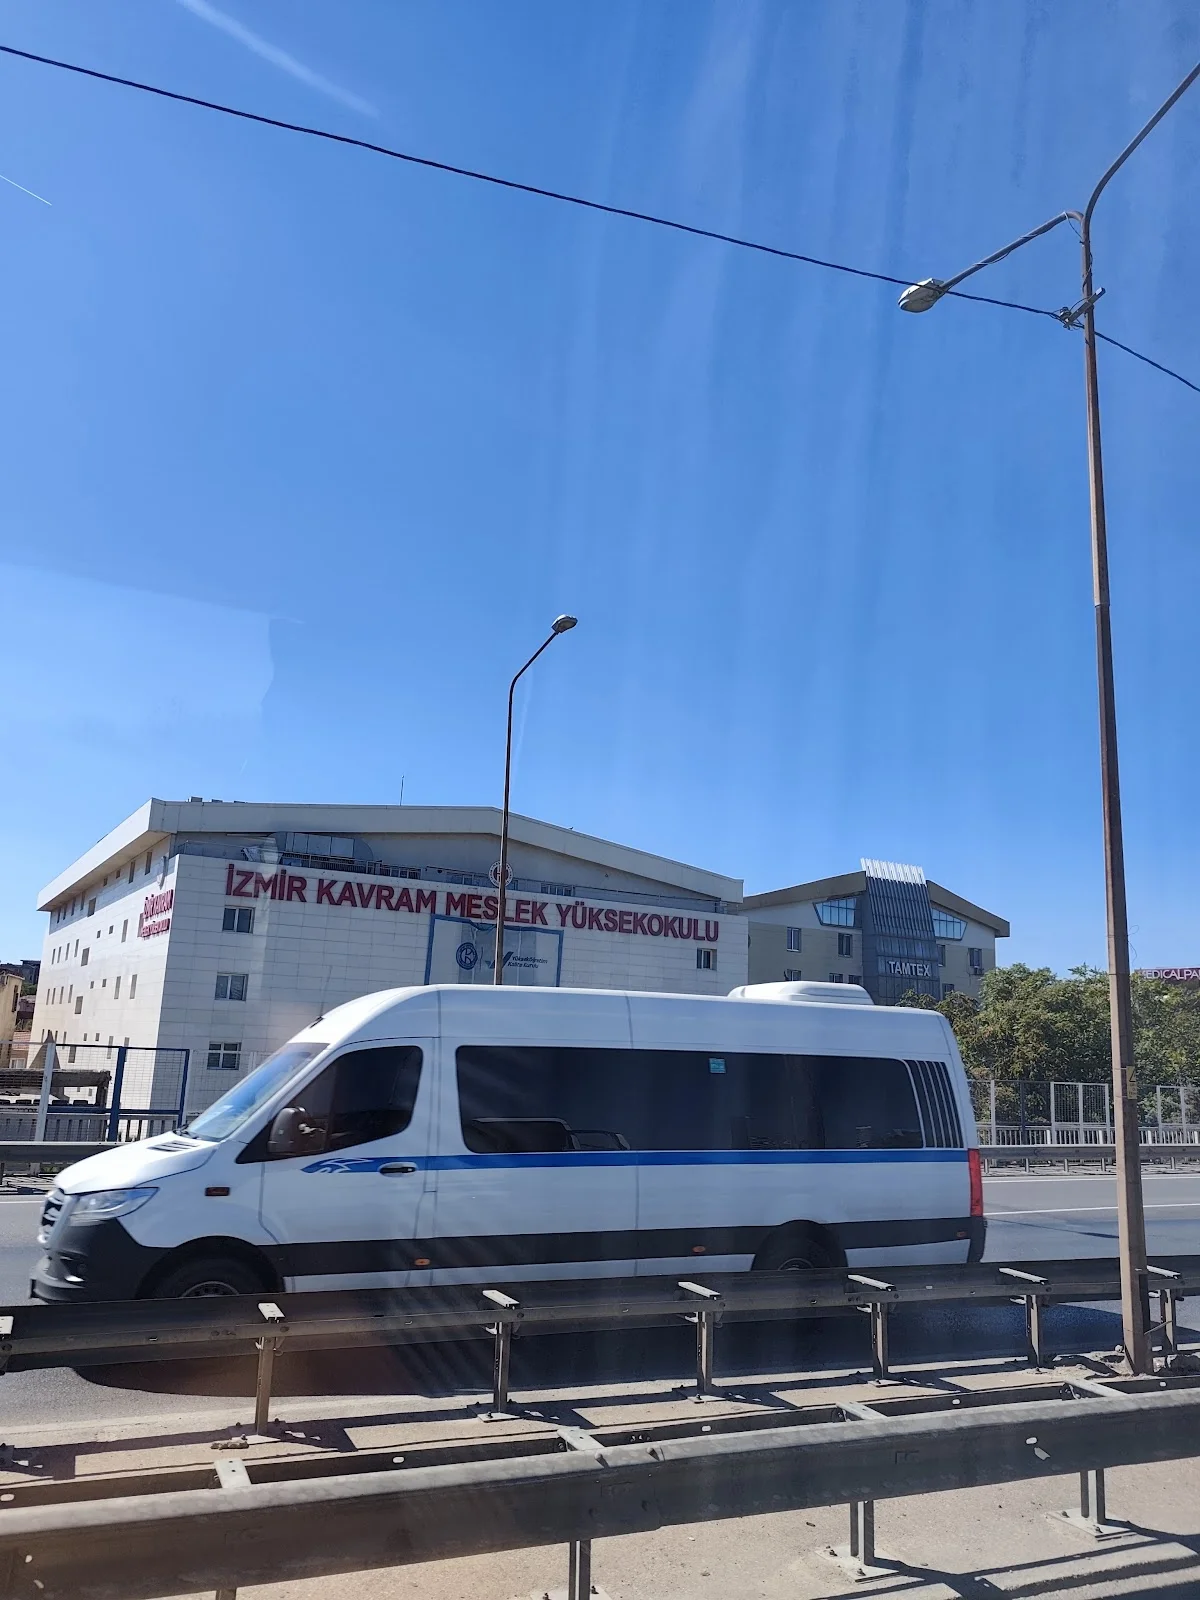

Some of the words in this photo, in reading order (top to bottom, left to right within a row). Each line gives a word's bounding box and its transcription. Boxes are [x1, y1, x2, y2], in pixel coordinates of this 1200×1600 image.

[225, 864, 307, 903] İZMİR
[316, 879, 437, 915] KAVRAM
[556, 901, 719, 942] YÜKSEKOKULU
[888, 961, 931, 977] TAMTEX
[1142, 968, 1200, 981] EDICALPA
